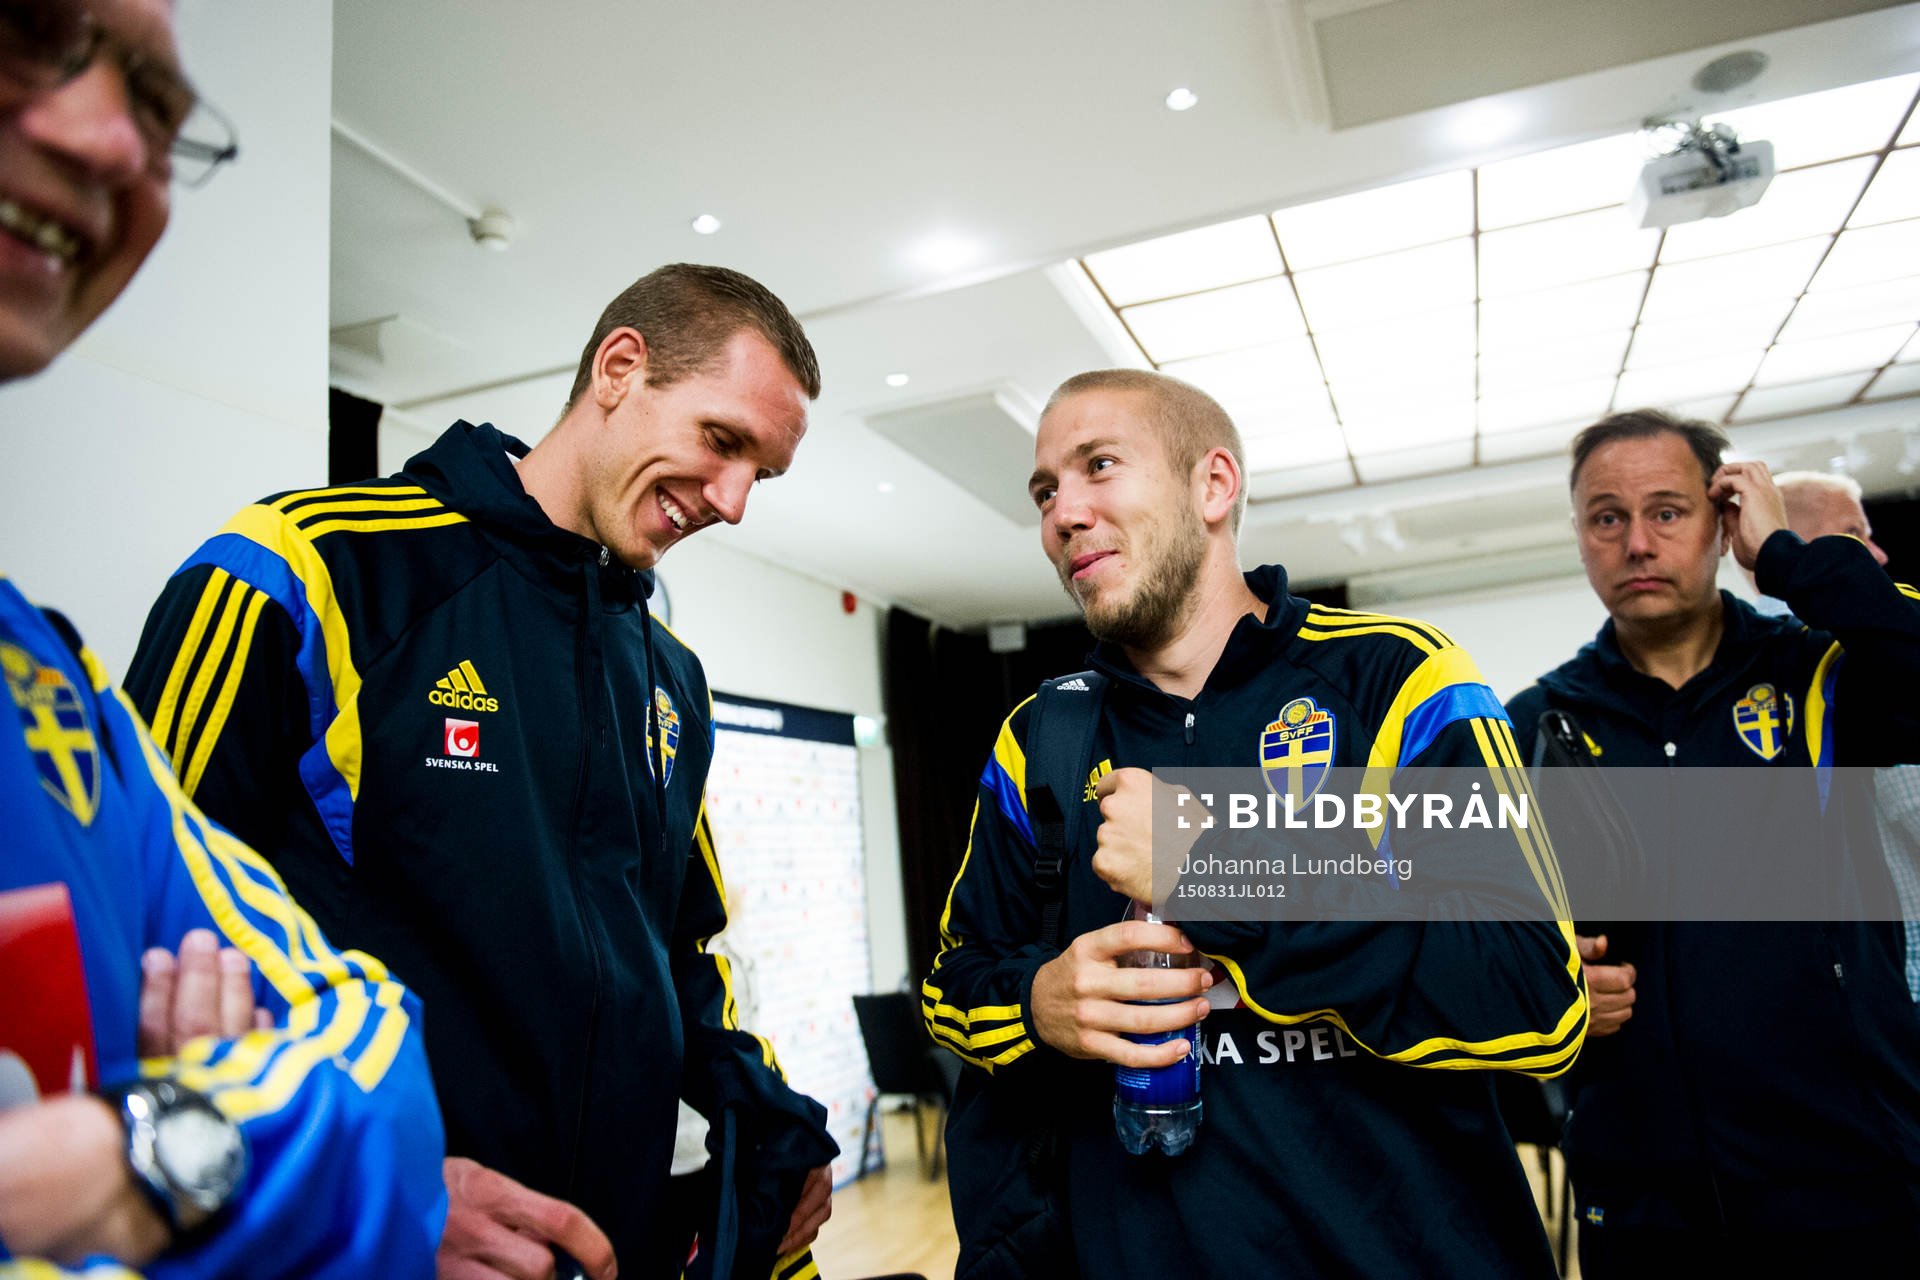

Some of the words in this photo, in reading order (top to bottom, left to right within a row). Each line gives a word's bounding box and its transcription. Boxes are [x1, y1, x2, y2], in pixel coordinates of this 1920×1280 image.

[428, 688, 499, 712] adidas
[1280, 726, 1314, 741] SvFF
[425, 757, 472, 770] SVENSKA
[474, 761, 499, 772] SPEL
[1256, 1025, 1357, 1065] SPEL
